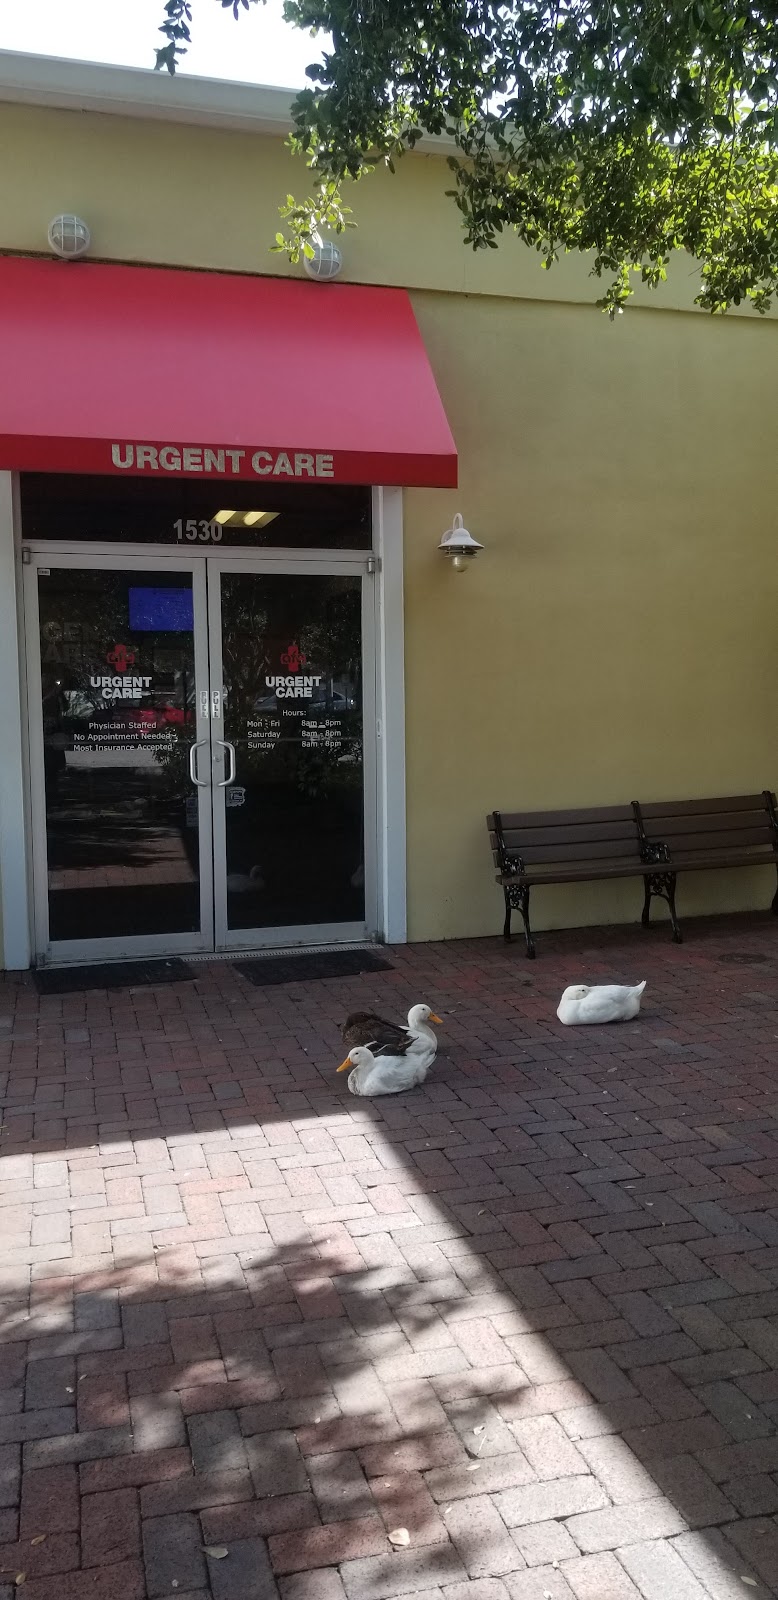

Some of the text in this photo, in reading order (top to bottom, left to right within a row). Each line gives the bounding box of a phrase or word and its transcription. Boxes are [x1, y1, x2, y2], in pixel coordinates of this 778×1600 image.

[111, 444, 335, 478] URGENT CARE
[172, 518, 224, 542] 1530
[90, 676, 153, 688] URGENT
[265, 676, 322, 687] URGENT
[101, 687, 143, 699] CARE
[275, 687, 313, 698] CARE
[282, 709, 307, 717] Hours:
[88, 721, 157, 731] Physician Staffed
[247, 720, 263, 728] Mon
[270, 720, 280, 728] Fri
[301, 719, 317, 727] 8am
[325, 719, 342, 729] 8pm
[73, 732, 171, 742] No Appointment Needed
[247, 731, 281, 739] Saturday
[301, 730, 317, 738] 8am
[325, 730, 342, 739] 8pm
[73, 743, 173, 753] Most Insurance Accepted
[247, 741, 276, 750] Sunday
[325, 741, 342, 750] 8pm
